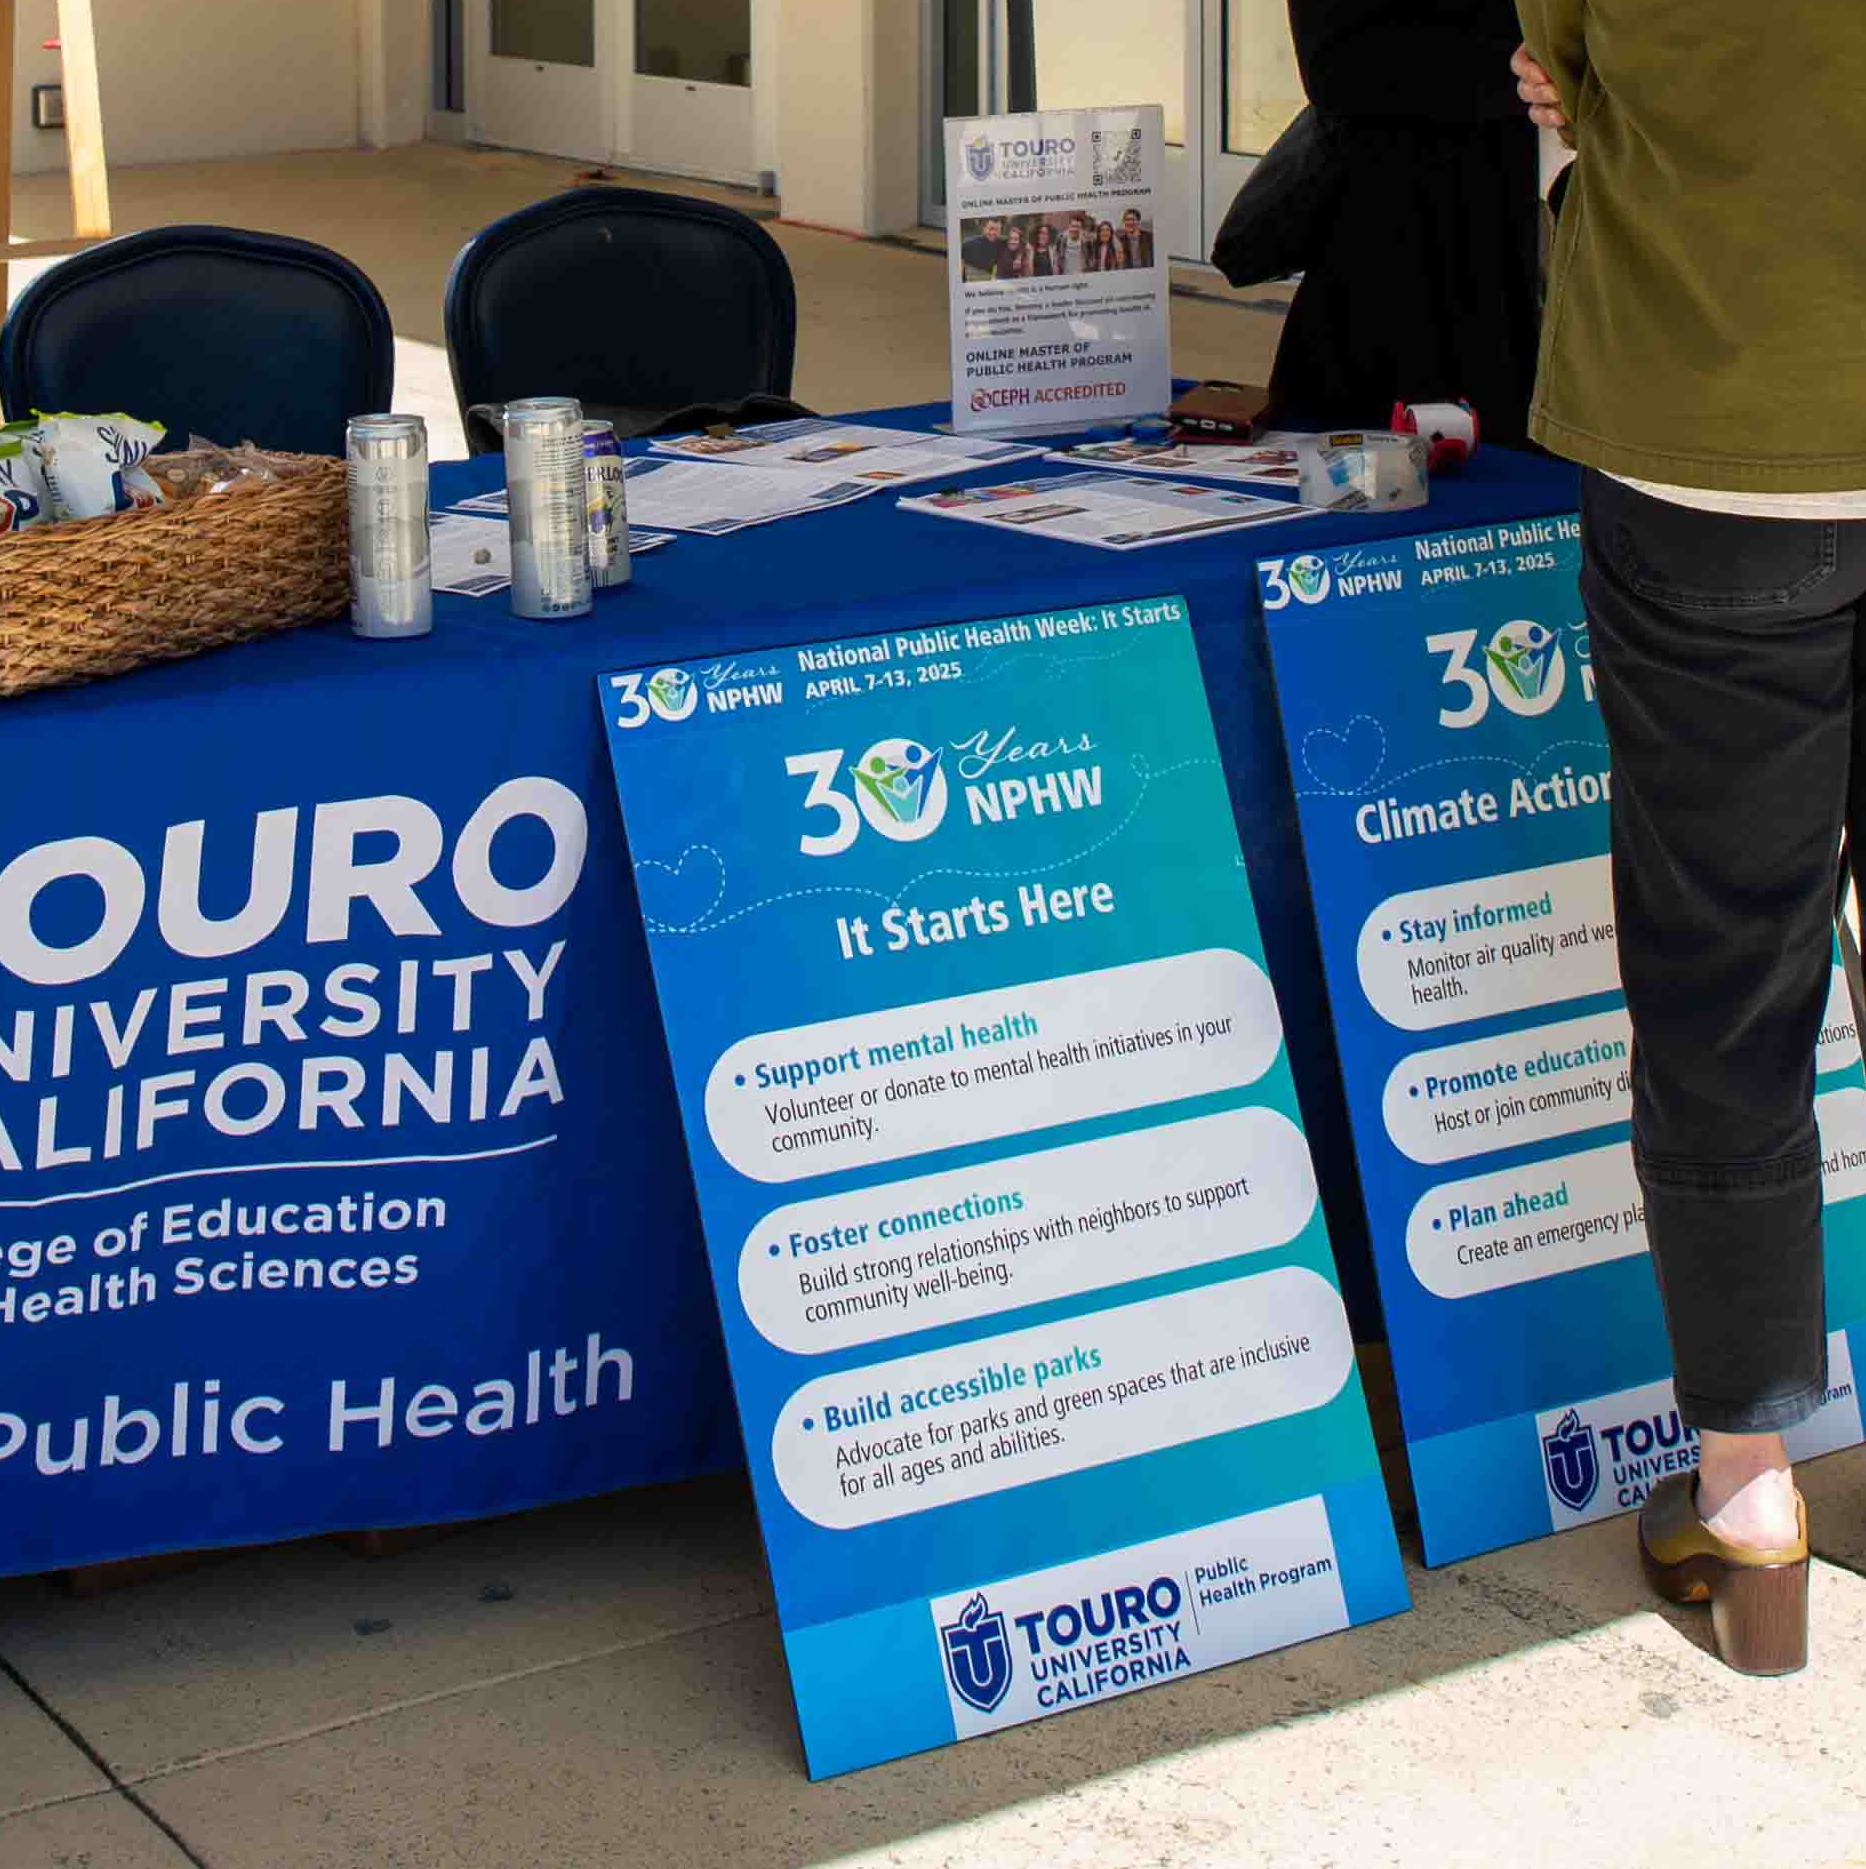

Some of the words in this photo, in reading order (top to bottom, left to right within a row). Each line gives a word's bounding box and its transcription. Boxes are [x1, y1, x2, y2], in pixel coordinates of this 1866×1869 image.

[966, 349, 1015, 364] ONLINE
[1019, 343, 1069, 357] MASTER
[1073, 342, 1089, 353] OF
[967, 364, 1014, 378] PUBLIC
[1017, 359, 1066, 373] HEALTH
[1070, 353, 1132, 367] PROGRAM
[1034, 382, 1126, 404] ACCREDITED
[798, 639, 890, 671] National
[896, 630, 960, 658] Public
[965, 621, 1031, 648] Health
[1035, 612, 1097, 638] Week:
[1101, 610, 1118, 629] It
[1122, 603, 1181, 627] Starts
[806, 677, 861, 699] APRIL
[865, 670, 911, 690] 7-13,
[917, 662, 962, 683] 2025
[949, 723, 1096, 779] Years
[965, 766, 1101, 825] NPHW
[1356, 790, 1498, 843] Climate
[837, 917, 873, 959] It
[883, 898, 1009, 950] Starts
[1019, 883, 1114, 926] Here
[1400, 919, 1446, 943] Stay
[1453, 891, 1552, 932] informed
[756, 1048, 861, 1089] Support
[869, 1027, 954, 1066] mental
[961, 1011, 1037, 1048] health
[765, 1094, 853, 1125] Volunteer
[861, 1089, 877, 1106] or
[885, 1075, 945, 1101] donate
[950, 1070, 969, 1088] to
[974, 1051, 1033, 1083] mental
[1037, 1043, 1090, 1070] health
[1095, 1030, 1173, 1059] initiatives
[1176, 1023, 1192, 1043] in
[1196, 1019, 1231, 1043] your
[1426, 1064, 1517, 1099] Promote
[1525, 1041, 1626, 1077] education
[773, 1116, 878, 1152] community.
[94, 1212, 148, 1257] of
[163, 1193, 445, 1243] Education
[789, 1224, 868, 1257] Foster
[879, 1192, 1023, 1238] connections
[1449, 1205, 1497, 1231] Plan
[1504, 1182, 1568, 1219] ahead
[799, 1263, 848, 1295] Build
[854, 1256, 912, 1287] strong
[918, 1230, 1029, 1267] relationships
[1033, 1215, 1073, 1241] with
[1079, 1201, 1160, 1233] neighbors
[1165, 1195, 1181, 1212] to
[1187, 1179, 1249, 1209] support
[173, 1252, 417, 1294] Sciences
[806, 1283, 907, 1323] community
[914, 1262, 1013, 1298] well-being.
[329, 1334, 632, 1451] Health
[824, 1392, 892, 1432] Build
[901, 1363, 1025, 1414] accessible
[1034, 1347, 1101, 1388] parks
[837, 1433, 922, 1469] Advocate
[928, 1422, 953, 1445] for
[960, 1408, 1013, 1443] parks
[1015, 1395, 1048, 1424] and
[1054, 1388, 1103, 1420] green
[1108, 1373, 1166, 1404] spaces
[1170, 1360, 1205, 1384] that
[1210, 1355, 1235, 1375] are
[1241, 1335, 1309, 1367] inclusive
[841, 1473, 865, 1496] for
[873, 1463, 894, 1489] all
[901, 1457, 944, 1485] ages
[951, 1440, 984, 1469] and
[991, 1427, 1064, 1459] abilities.
[1195, 1557, 1248, 1584] Public
[1200, 1578, 1256, 1606] Health
[1260, 1559, 1332, 1590] Program
[1015, 1578, 1181, 1655] TOURO
[1031, 1621, 1180, 1682] UNIVERSITY
[1038, 1648, 1191, 1708] CALIFORNIA
